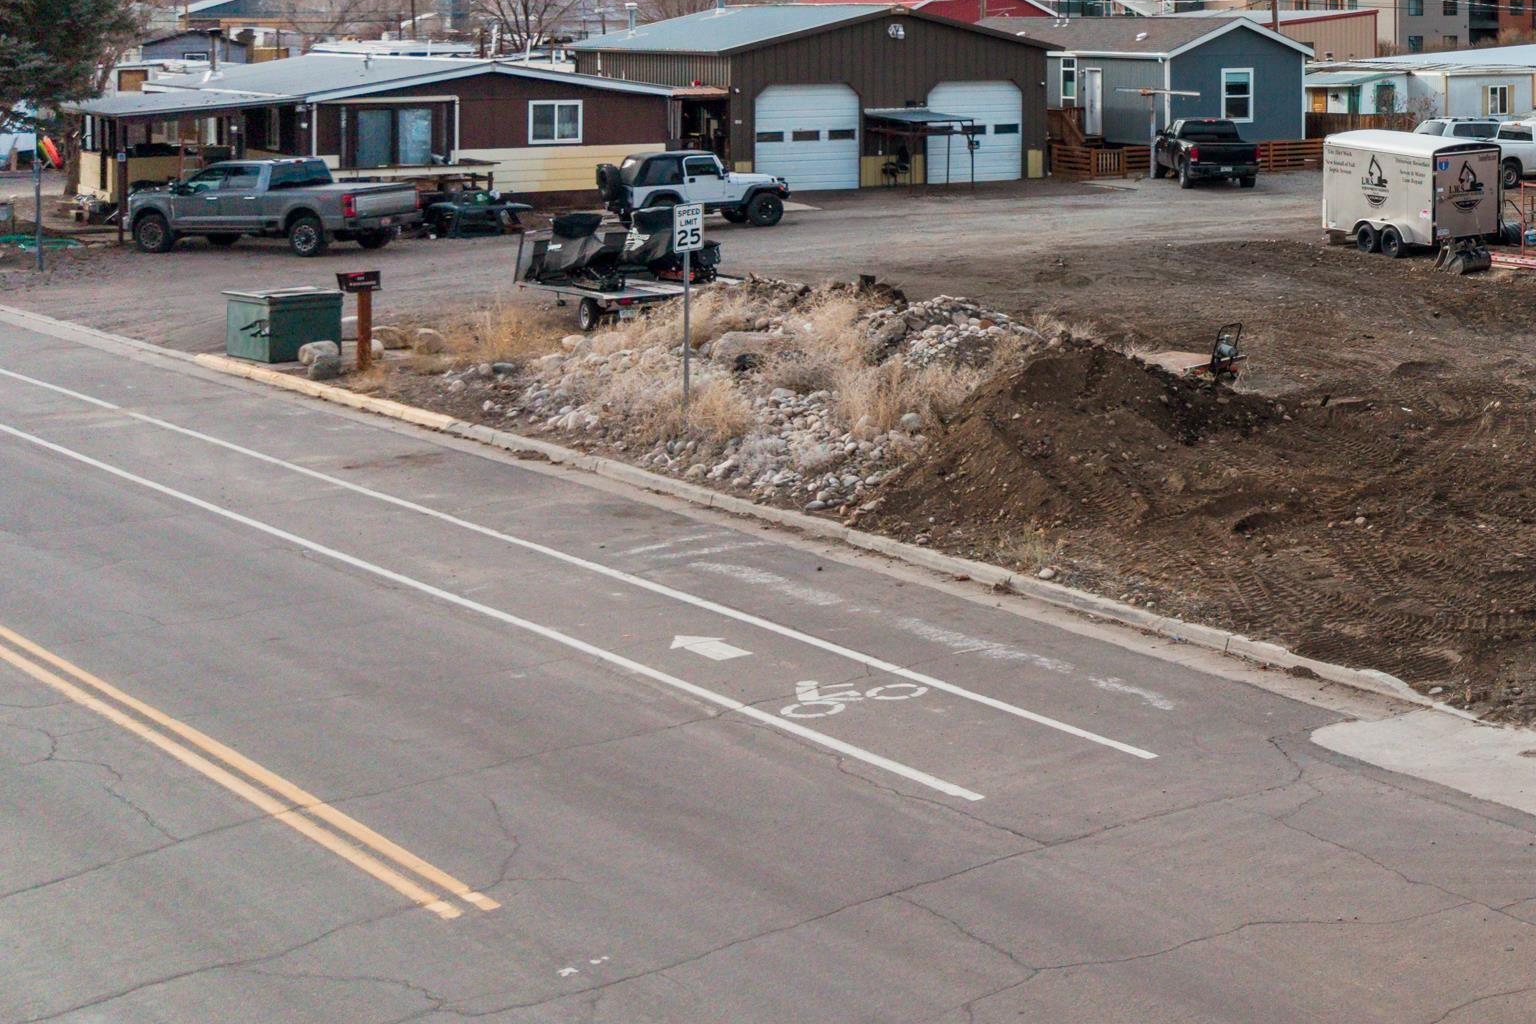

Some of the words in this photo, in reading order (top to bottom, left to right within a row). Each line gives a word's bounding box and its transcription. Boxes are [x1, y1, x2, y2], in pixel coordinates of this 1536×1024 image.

[677, 208, 701, 217] SPEED
[679, 218, 698, 227] LIMIT
[677, 228, 701, 247] 25
